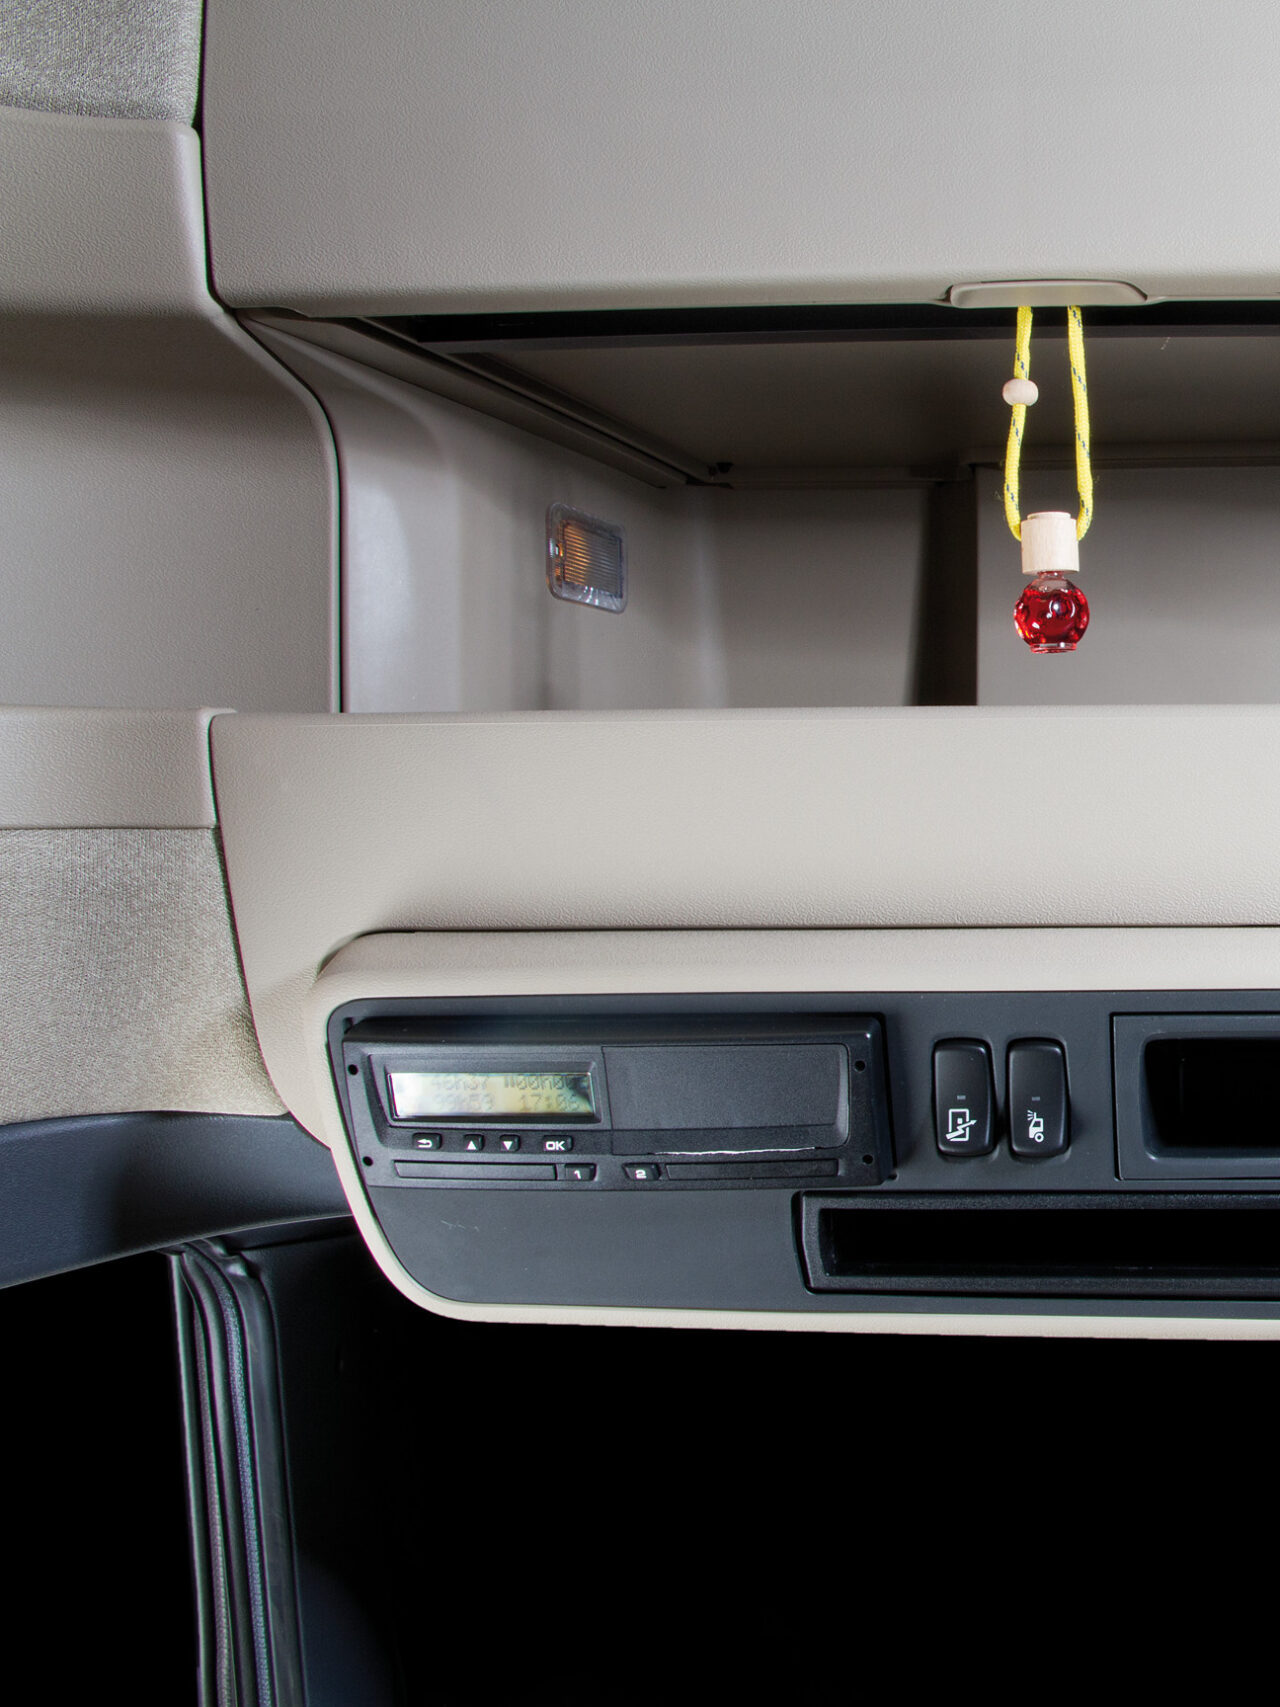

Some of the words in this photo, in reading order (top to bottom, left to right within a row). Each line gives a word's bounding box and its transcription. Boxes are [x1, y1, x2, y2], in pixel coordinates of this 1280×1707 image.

[545, 1140, 566, 1151] OK
[573, 1169, 582, 1180] 1
[635, 1169, 647, 1179] 2
